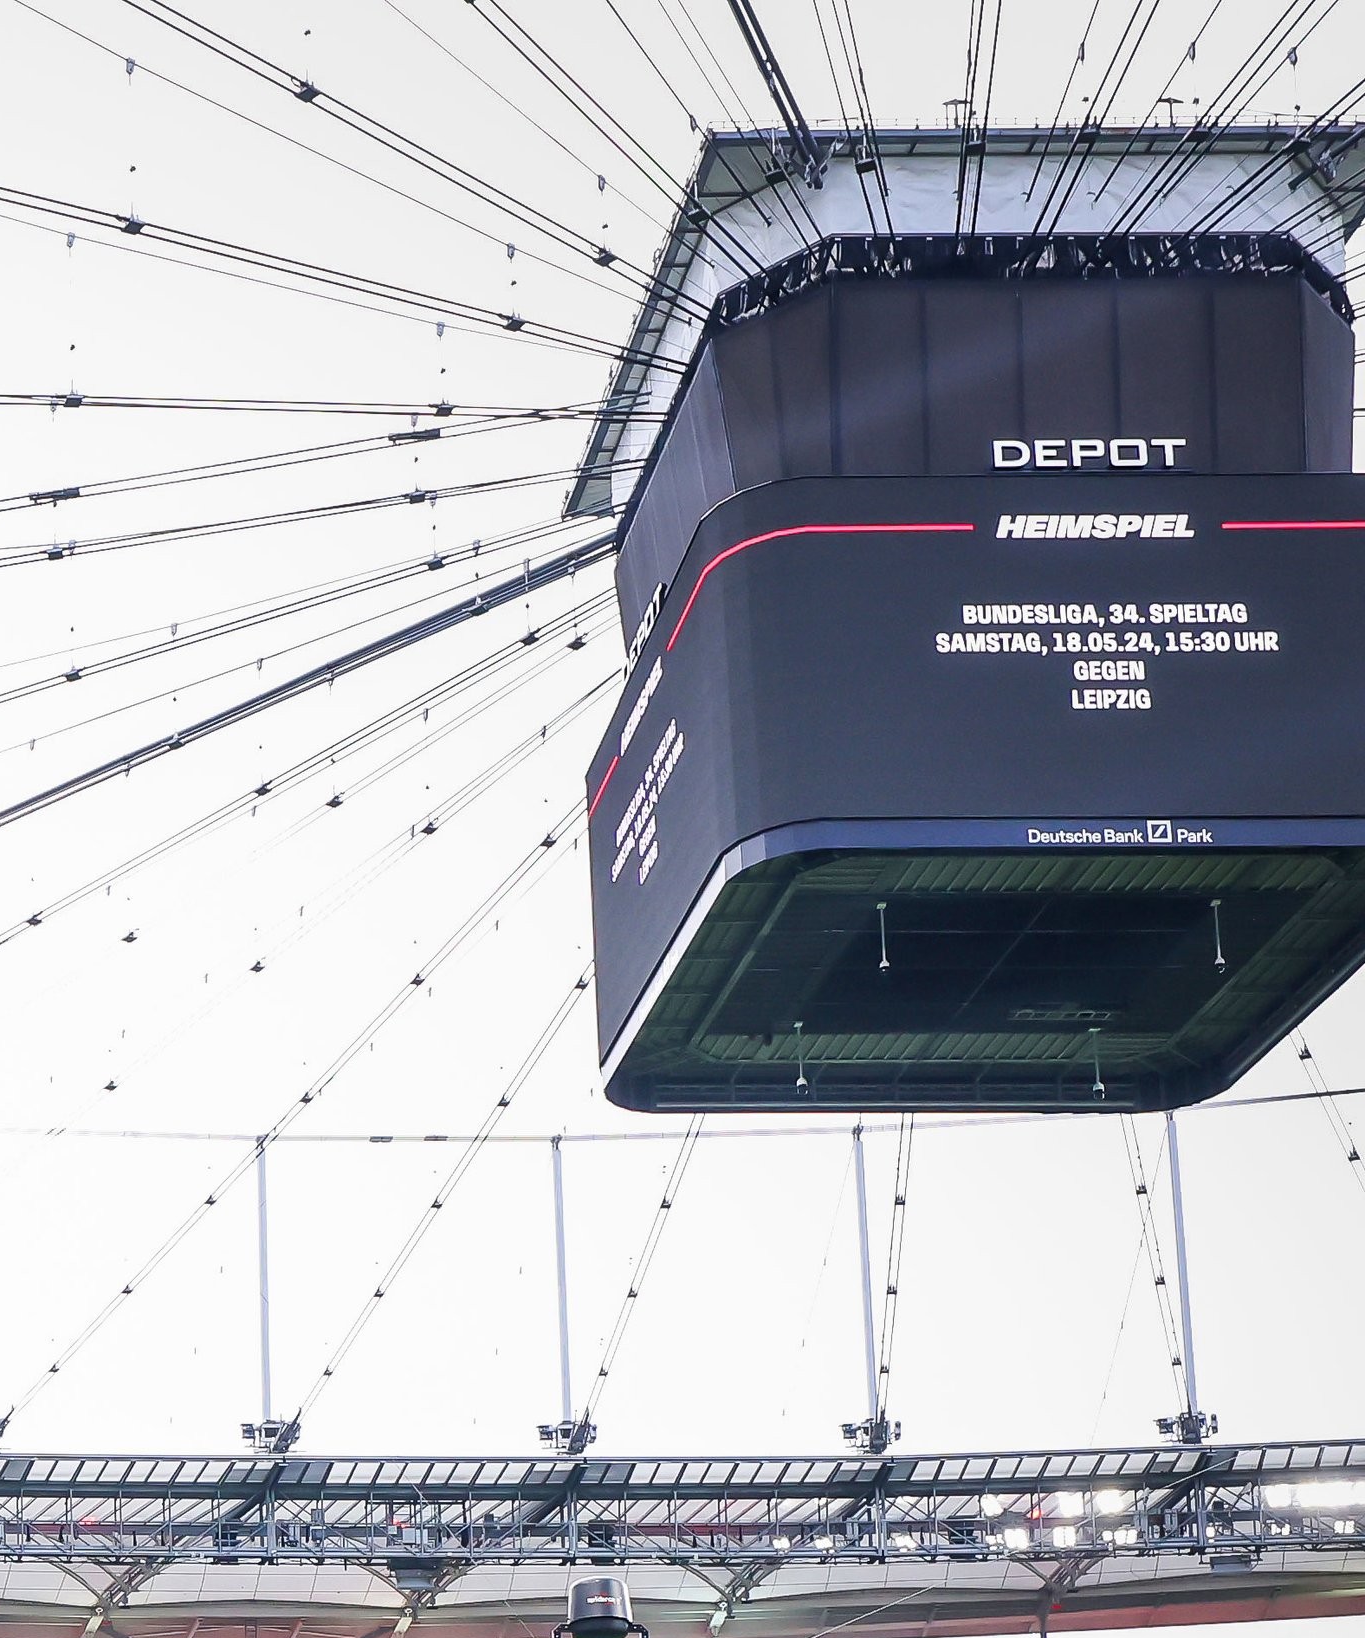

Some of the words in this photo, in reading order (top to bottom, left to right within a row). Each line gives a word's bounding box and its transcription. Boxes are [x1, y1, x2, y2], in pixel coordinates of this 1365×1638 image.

[992, 437, 1187, 469] DEPOT
[995, 513, 1196, 540] HEIMSPIEL
[962, 604, 1105, 628] BUNDESLIGA,
[1109, 604, 1146, 624] 34.
[1149, 603, 1248, 624] SPIELTAG
[621, 582, 666, 682] DEPOT
[935, 632, 1048, 656] SAMSTAG,
[1052, 632, 1161, 656] 18.05.24,
[1165, 631, 1231, 652] 15:30
[1234, 631, 1279, 652] UHR
[1073, 660, 1146, 681] GEGEN
[1071, 689, 1152, 710] LEIPZIG
[1027, 828, 1102, 844] Deutsche
[1104, 828, 1145, 844] Bank
[1176, 828, 1214, 844] Park
